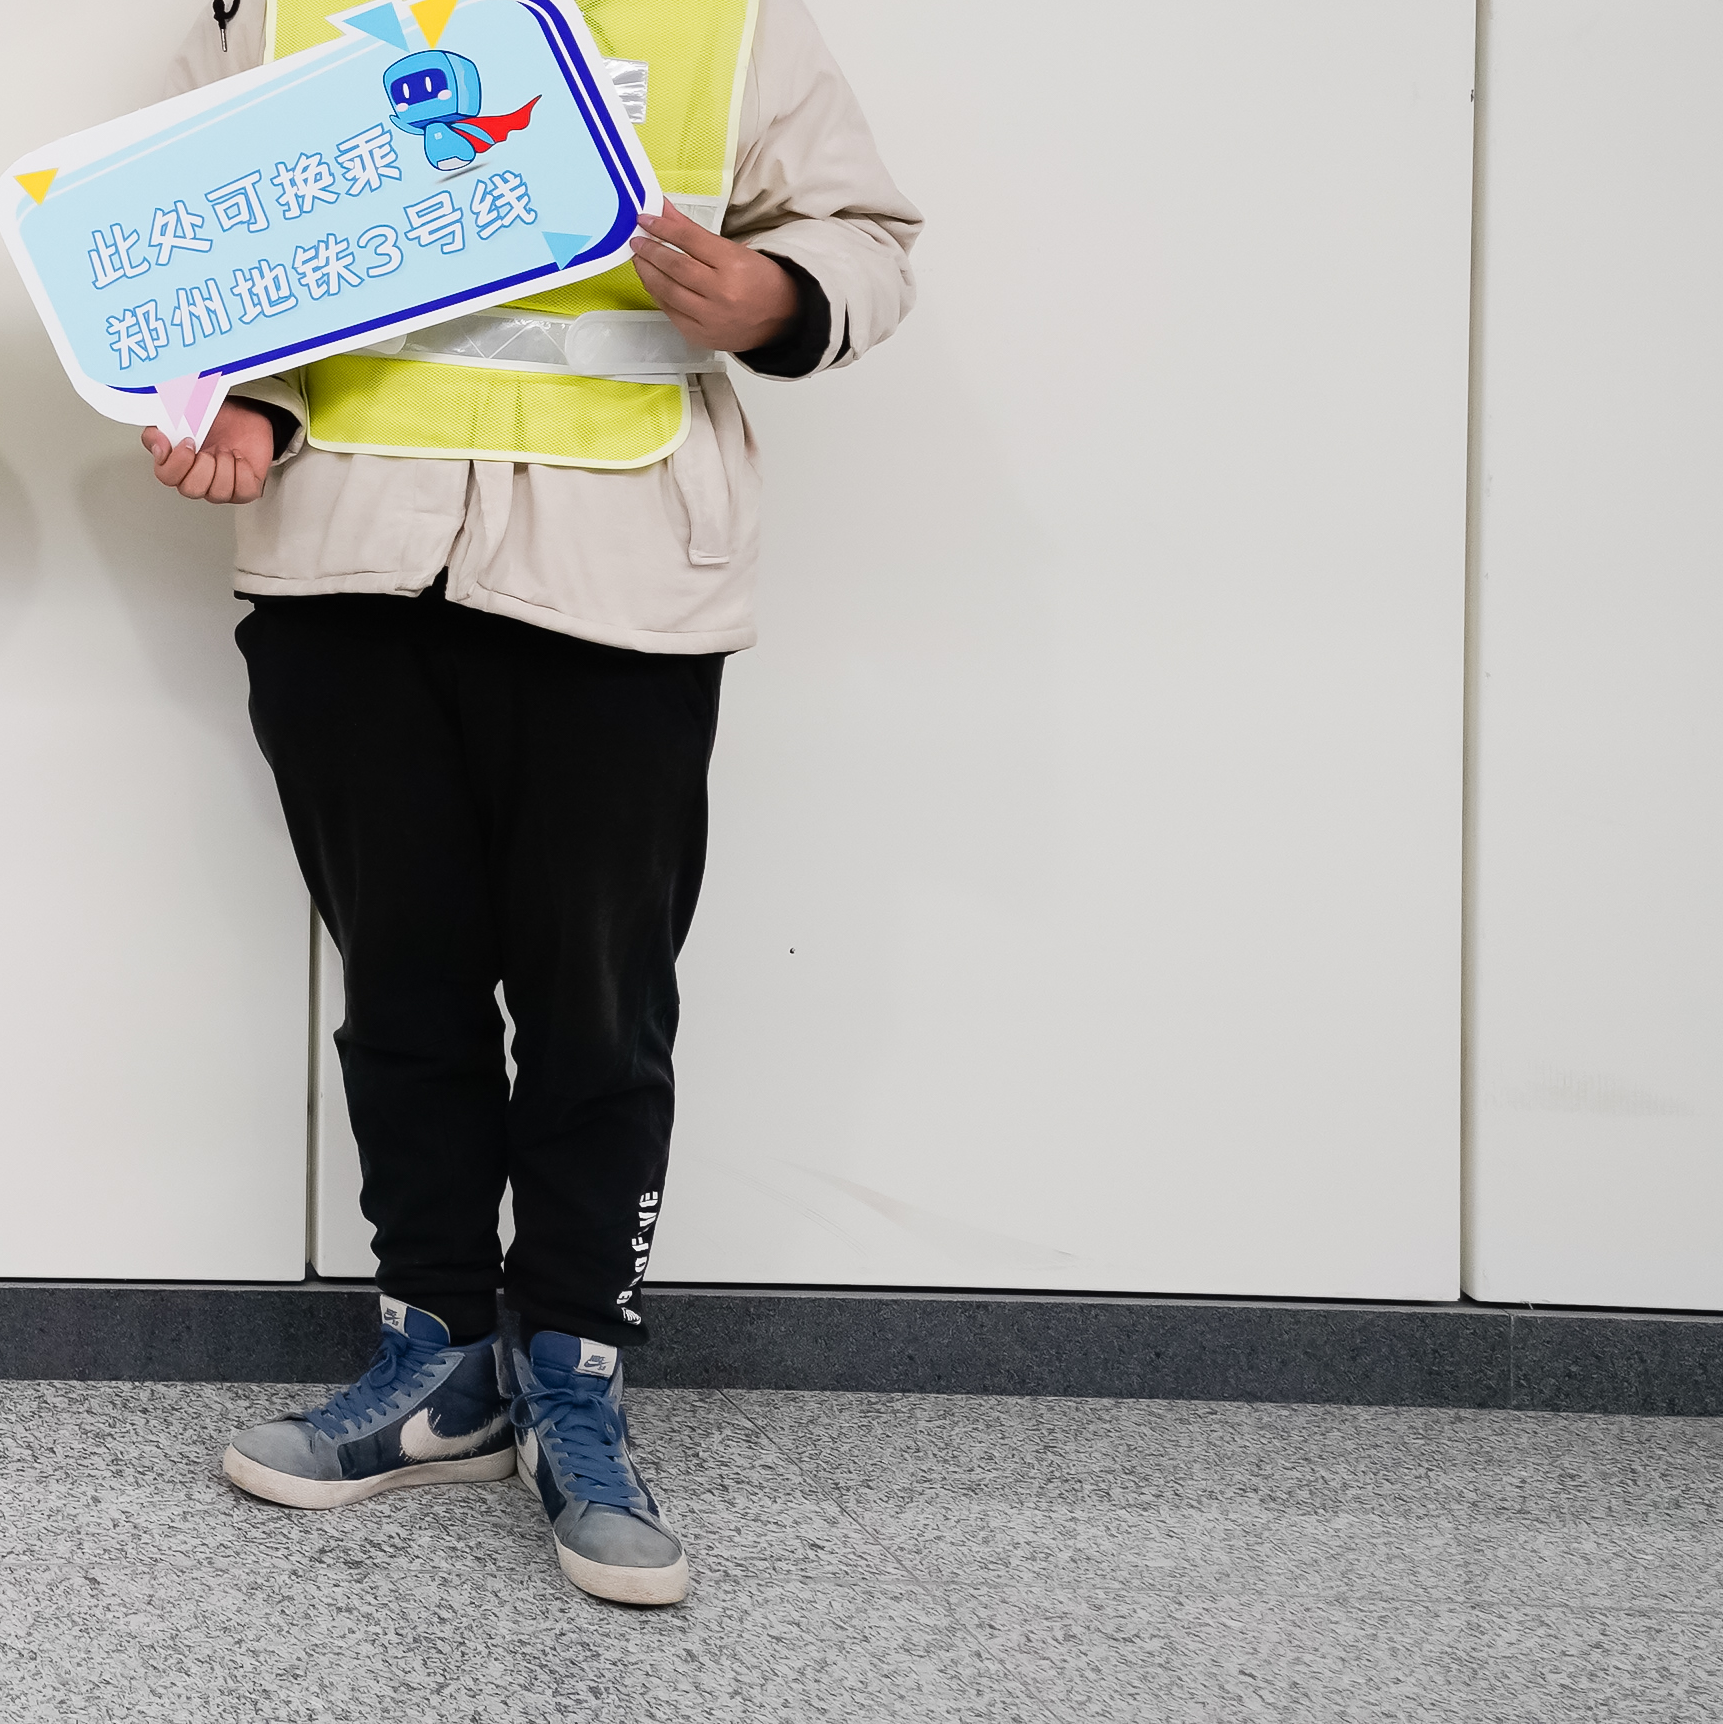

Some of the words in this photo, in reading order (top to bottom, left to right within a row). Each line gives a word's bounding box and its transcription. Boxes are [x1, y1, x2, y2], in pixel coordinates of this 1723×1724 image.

[87, 123, 403, 291] 此处可换乘
[105, 170, 539, 369] 郑州地铁3号线
